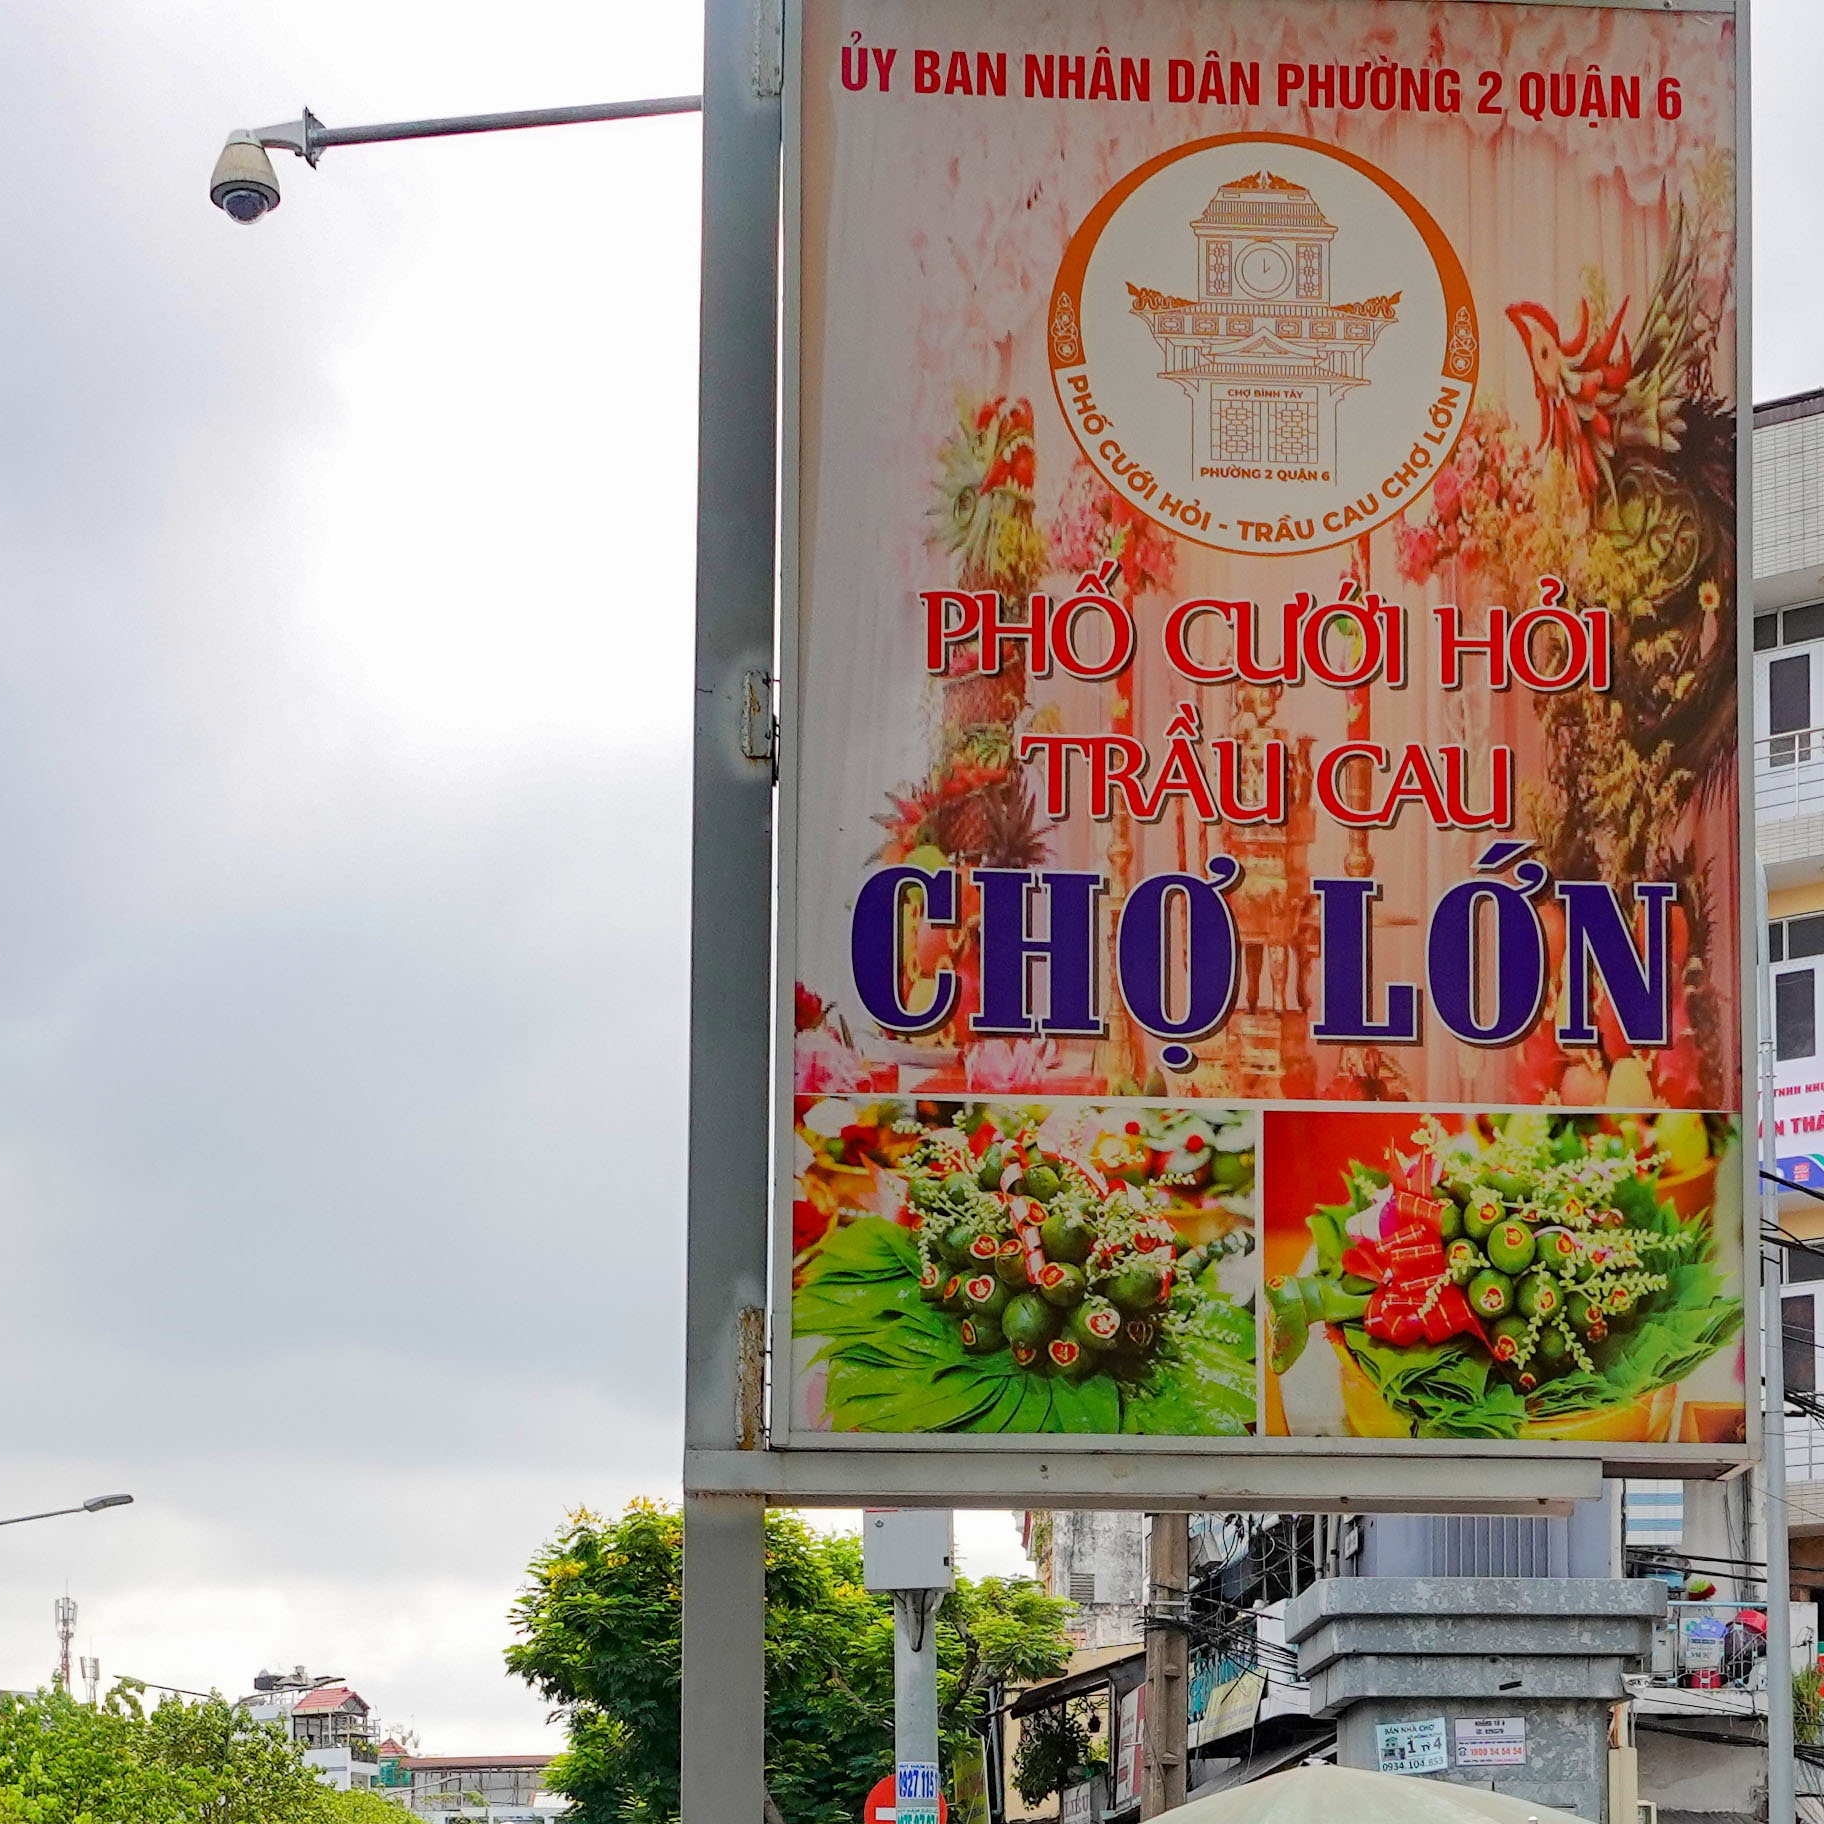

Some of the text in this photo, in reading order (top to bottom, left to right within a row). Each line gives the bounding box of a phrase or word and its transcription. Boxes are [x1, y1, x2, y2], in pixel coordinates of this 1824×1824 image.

[841, 29, 1684, 129] ỦY BAN NHÂN DÂN PHƯỜNG 2 QUẬN 6
[1227, 387, 1253, 400] CHỢ
[1066, 374, 1115, 436] PHỐ
[1098, 439, 1156, 501] CƯỚI
[1157, 488, 1212, 532] HỎI
[1236, 514, 1315, 543] TRẦU
[1324, 492, 1381, 531] CAU
[1381, 442, 1435, 499] CHỢ
[1424, 385, 1463, 445] LỚN
[1200, 465, 1331, 484] PHƯỜNG 2 QUẬN 6
[920, 560, 1613, 693] PHỐ CƯỚI HỎI
[1019, 702, 1515, 829] TRẦU CAU
[851, 841, 1679, 1072] CHỢ LỚN
